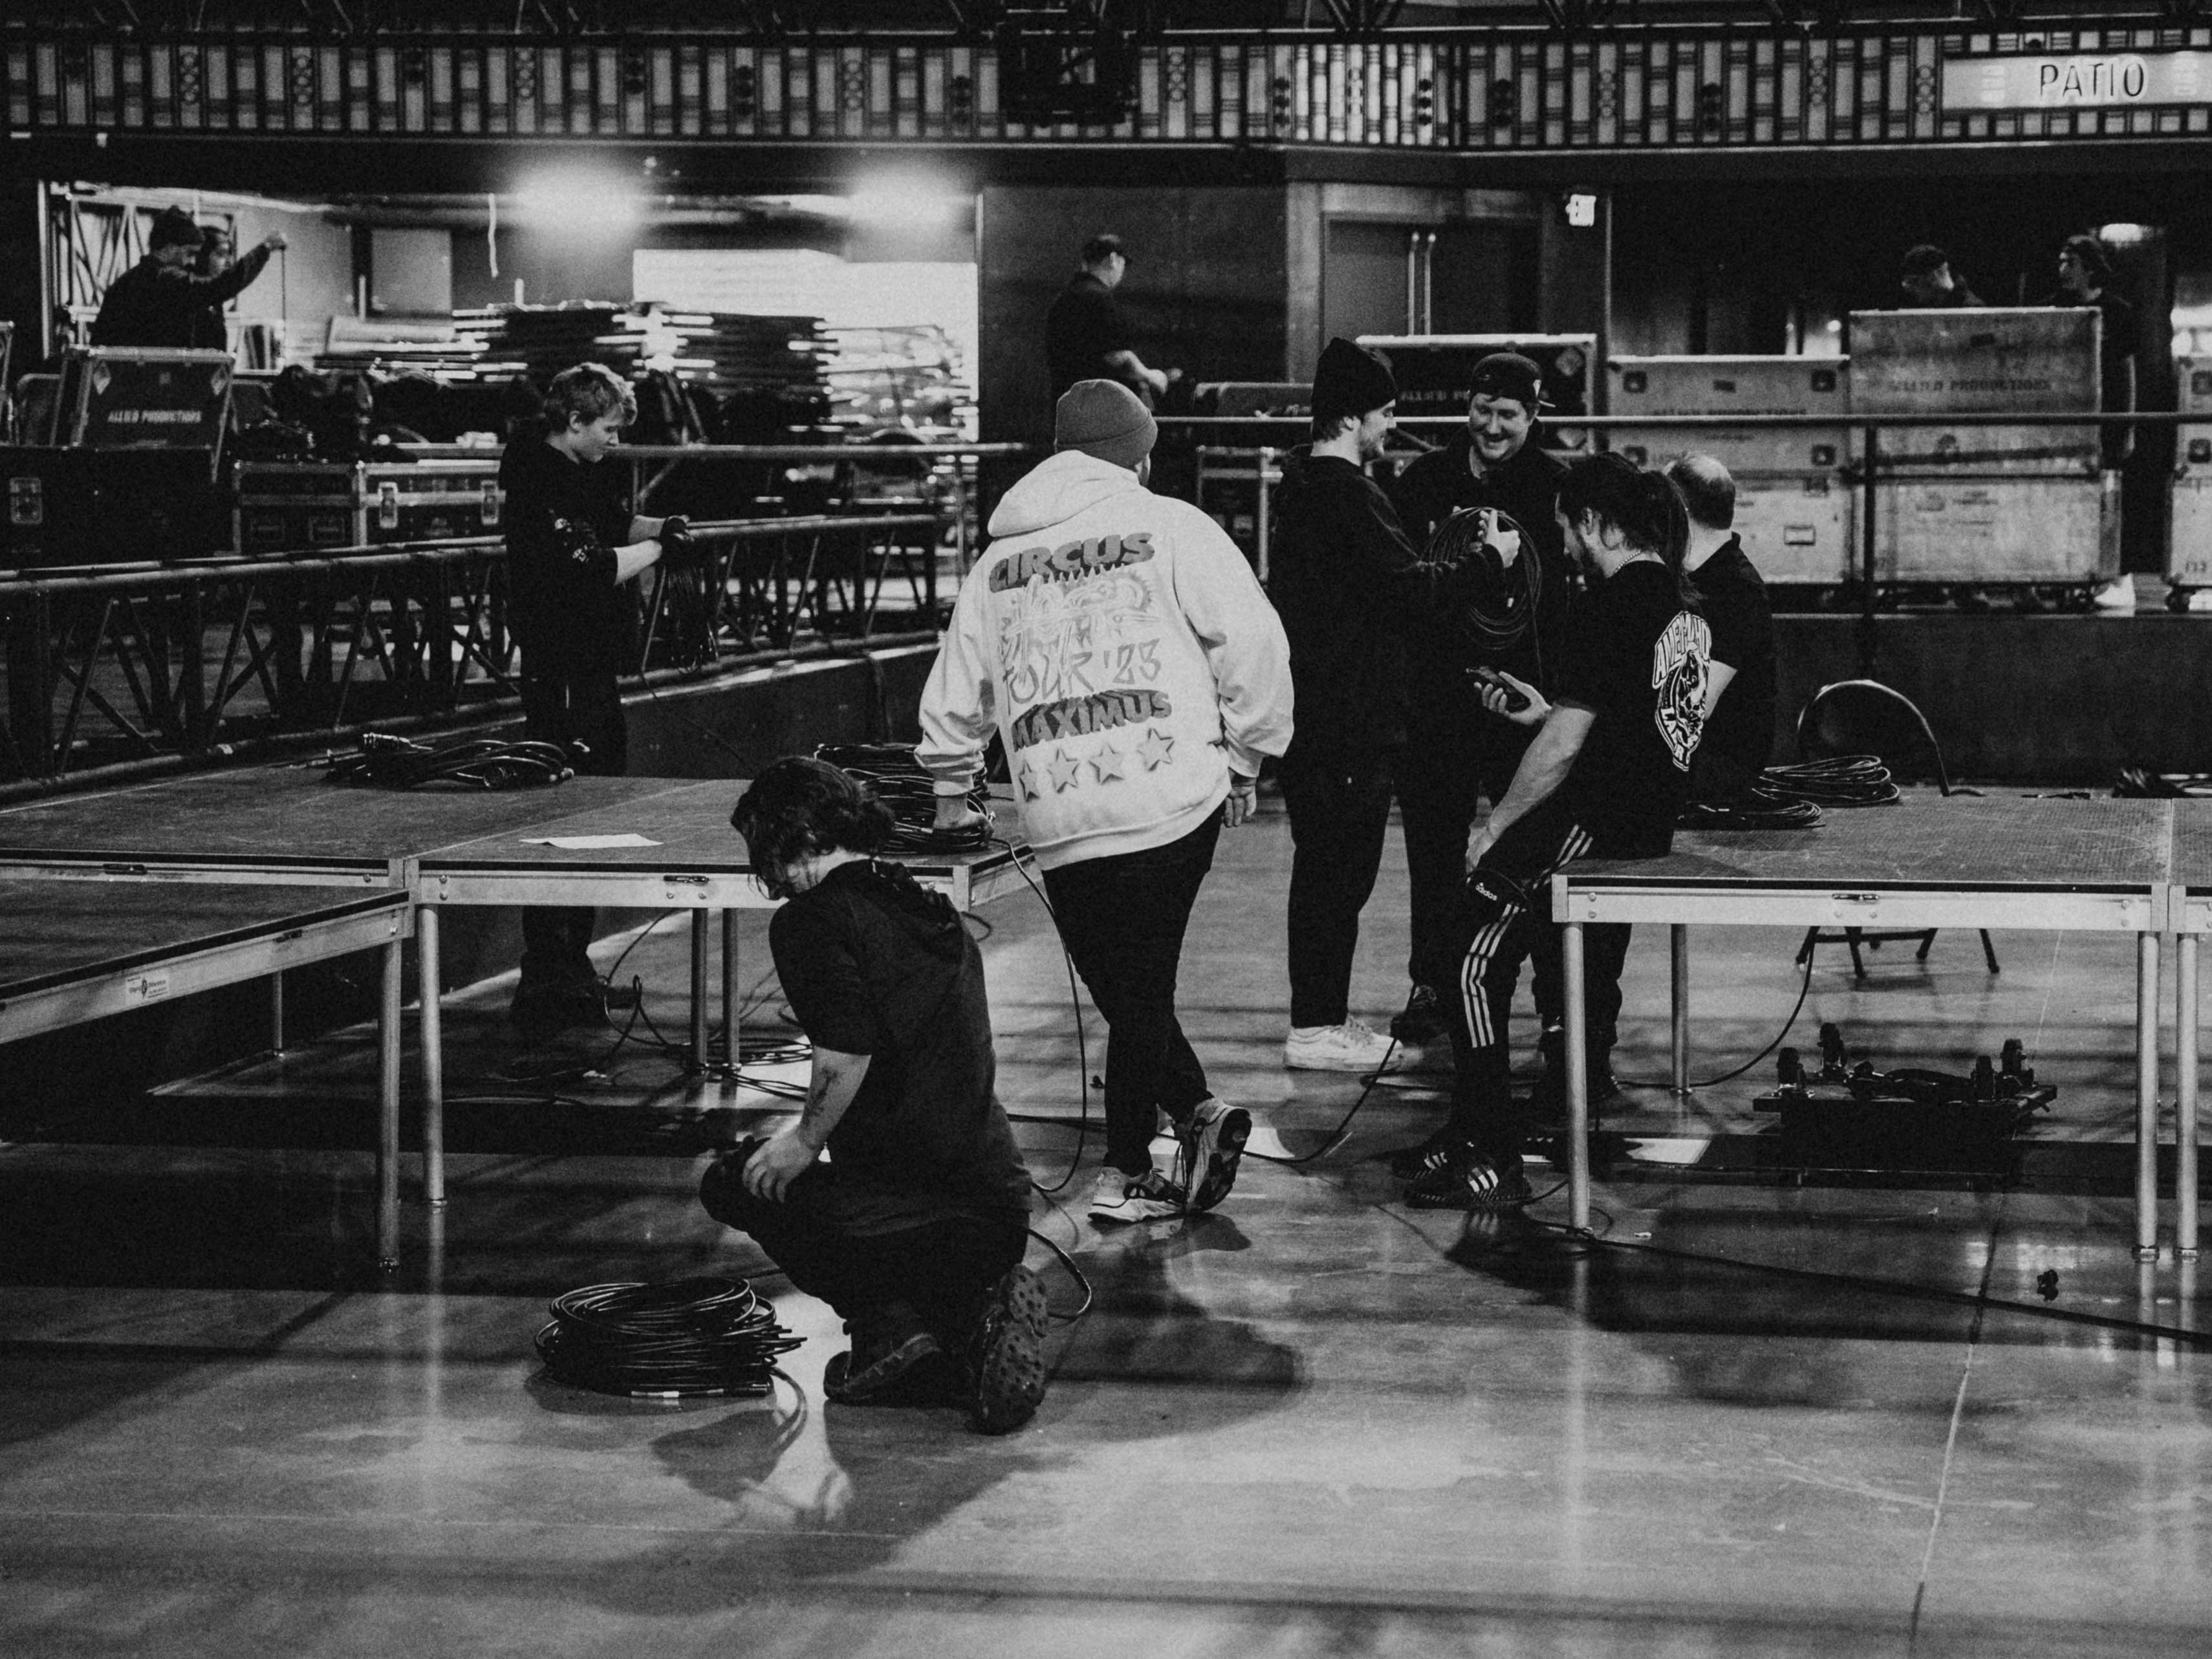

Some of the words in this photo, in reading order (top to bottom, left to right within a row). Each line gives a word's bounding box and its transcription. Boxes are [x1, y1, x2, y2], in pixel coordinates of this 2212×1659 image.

[2039, 62, 2145, 97] PATIO
[988, 532, 1155, 594] CIRCUS
[1011, 689, 1173, 754] MAXIMUS
[1475, 882, 1498, 902] adidas
